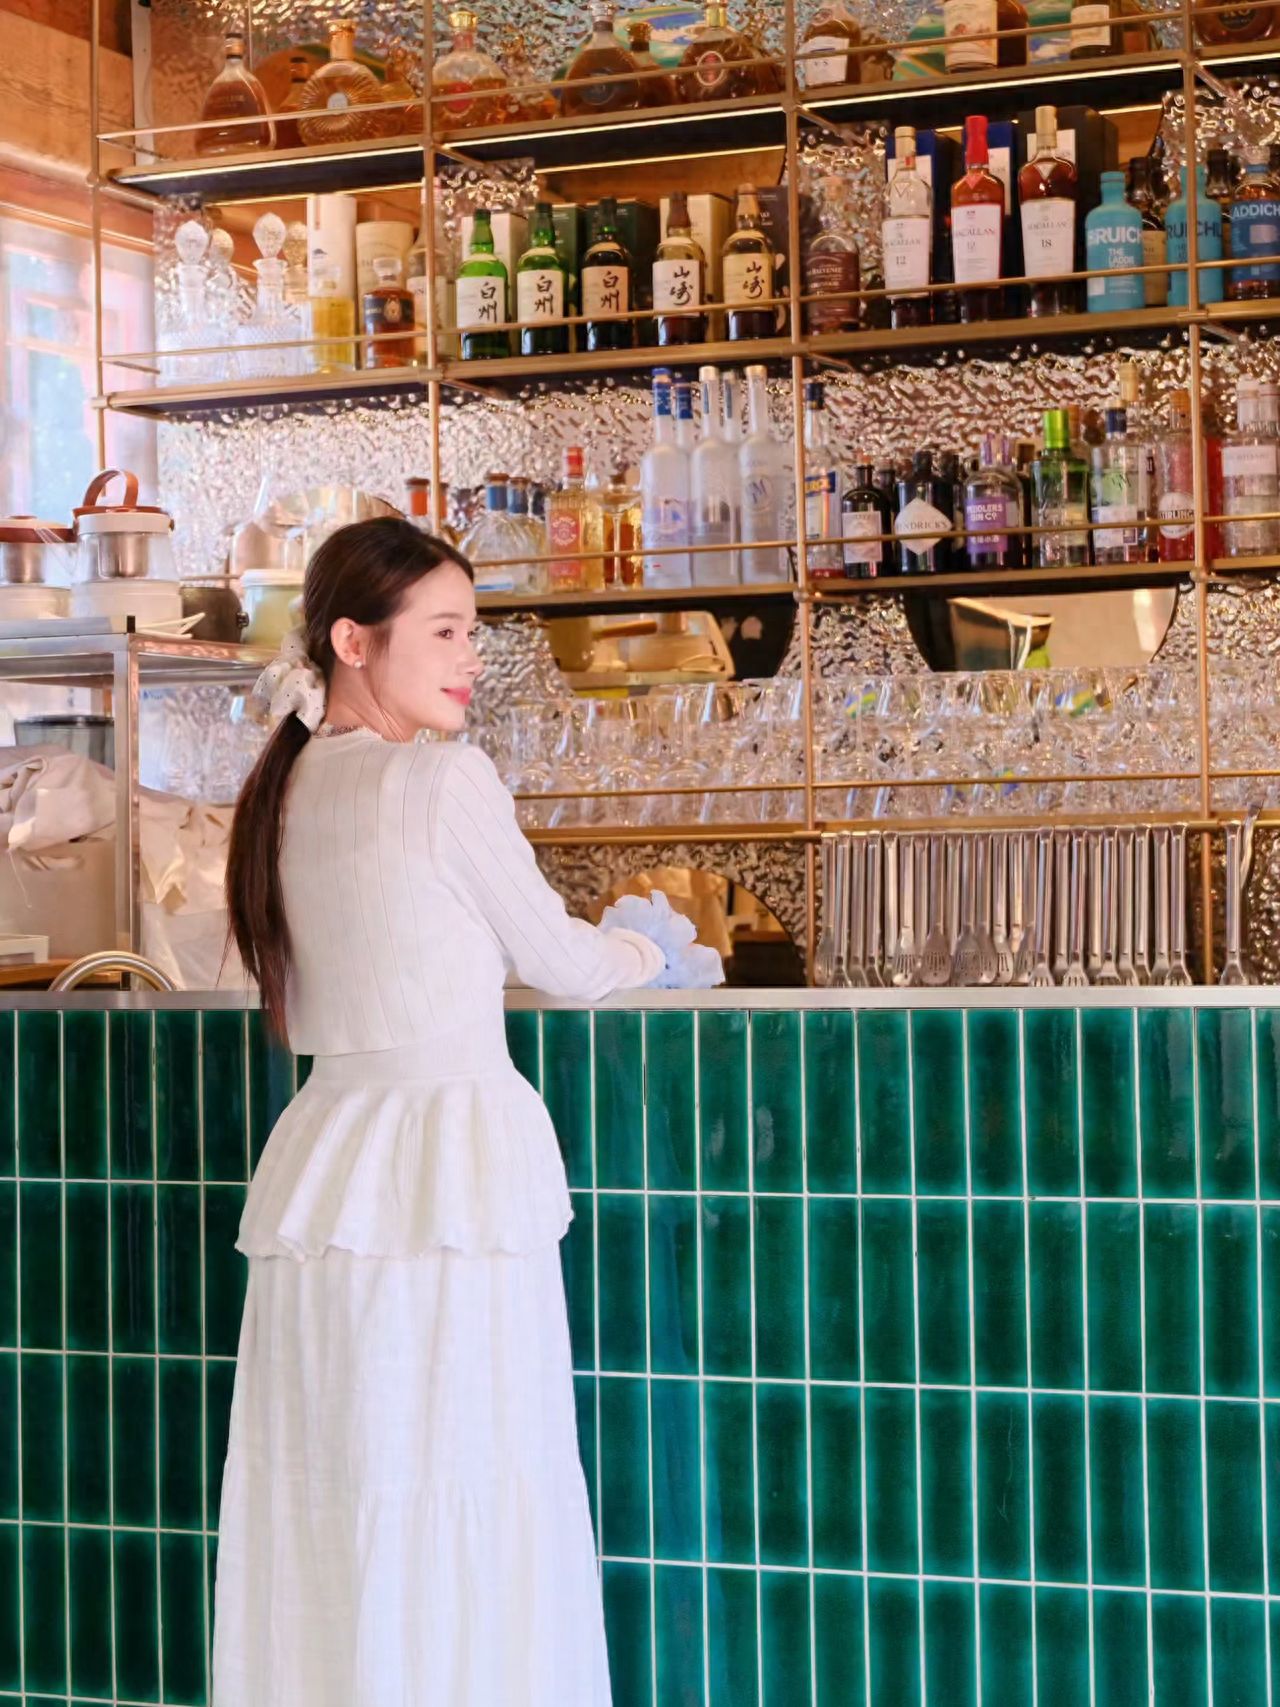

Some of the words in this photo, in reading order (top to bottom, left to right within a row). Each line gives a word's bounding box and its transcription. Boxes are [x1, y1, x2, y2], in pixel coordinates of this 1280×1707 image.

[1232, 203, 1280, 219] ADDICH
[1041, 238, 1053, 248] 18
[534, 275, 553, 316] 白州
[600, 270, 620, 312] 白州
[669, 265, 693, 306] 山崎
[742, 260, 765, 299] 山崎
[478, 281, 497, 323] 白州
